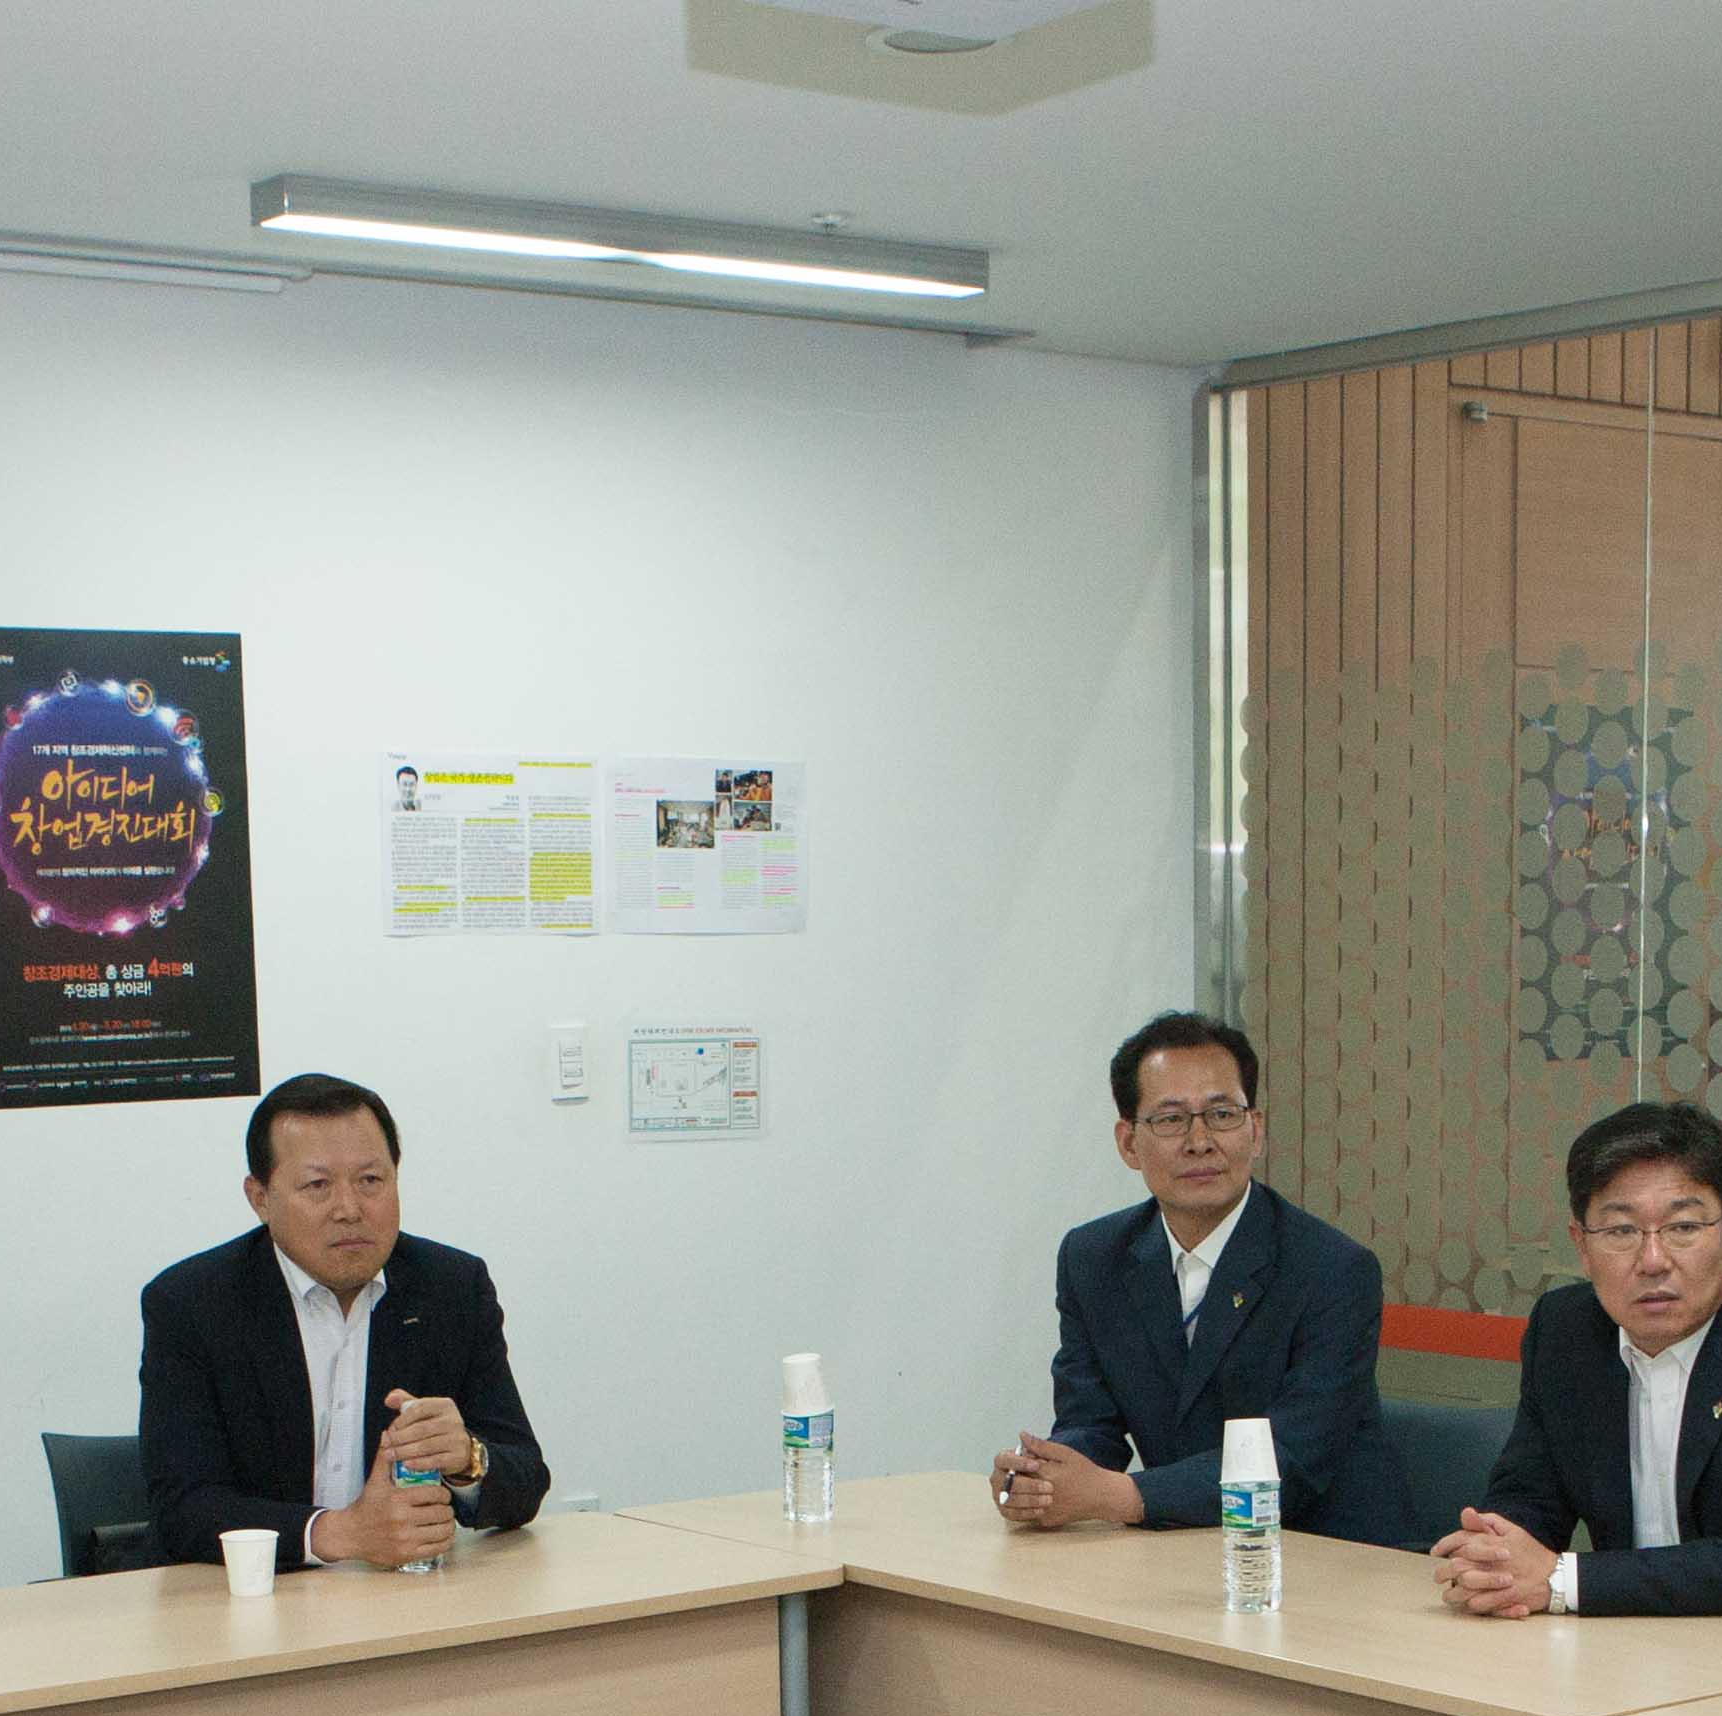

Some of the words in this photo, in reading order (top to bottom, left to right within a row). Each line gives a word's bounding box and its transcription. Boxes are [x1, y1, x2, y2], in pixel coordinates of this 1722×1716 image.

[42, 758, 155, 811] 아이디어
[10, 797, 195, 855] 창업경진대회
[121, 964, 144, 979] 상금
[63, 982, 110, 998] 주인공을
[113, 981, 152, 997] 찾아라!
